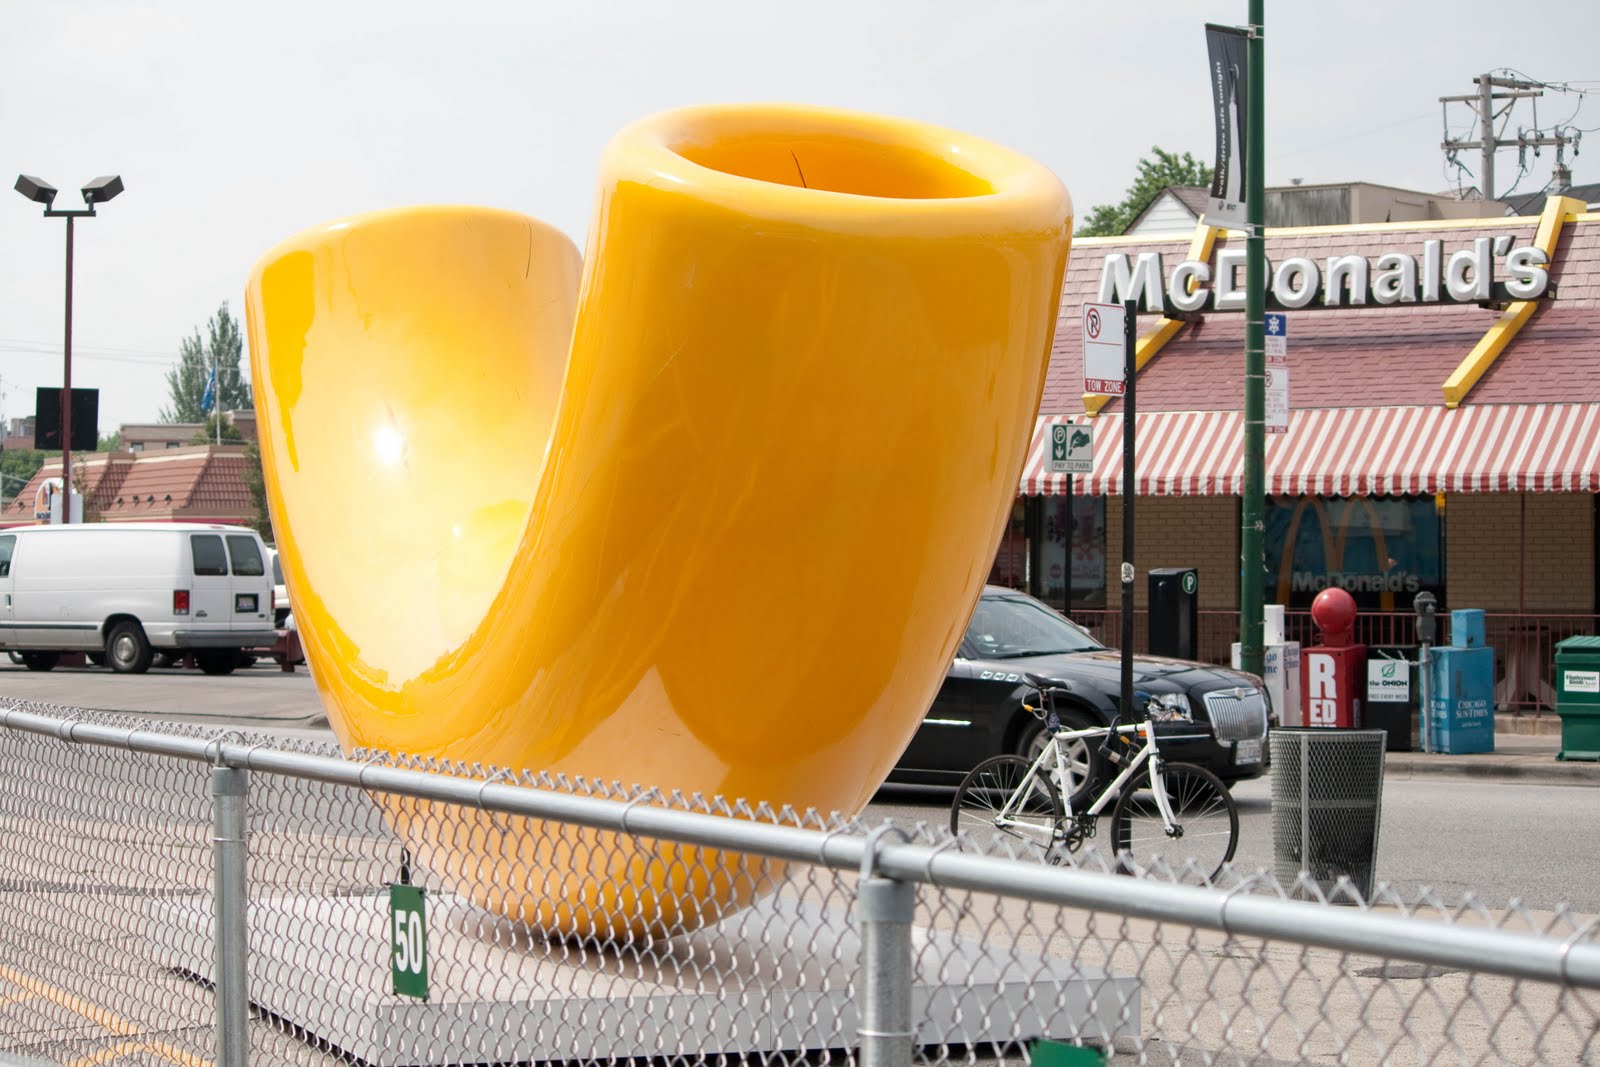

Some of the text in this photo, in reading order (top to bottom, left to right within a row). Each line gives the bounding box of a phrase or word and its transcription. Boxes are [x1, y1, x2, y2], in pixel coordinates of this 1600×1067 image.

[1216, 62, 1224, 104] tonight
[1098, 235, 1548, 312] McDonald's
[1087, 380, 1122, 393] TOW ZONE
[1054, 461, 1090, 469] PAY TO PARK
[1292, 571, 1419, 592] McDonald's
[1457, 699, 1486, 709] CHICAGO
[1455, 708, 1488, 718] SUN-TIMES
[395, 909, 422, 974] 50
